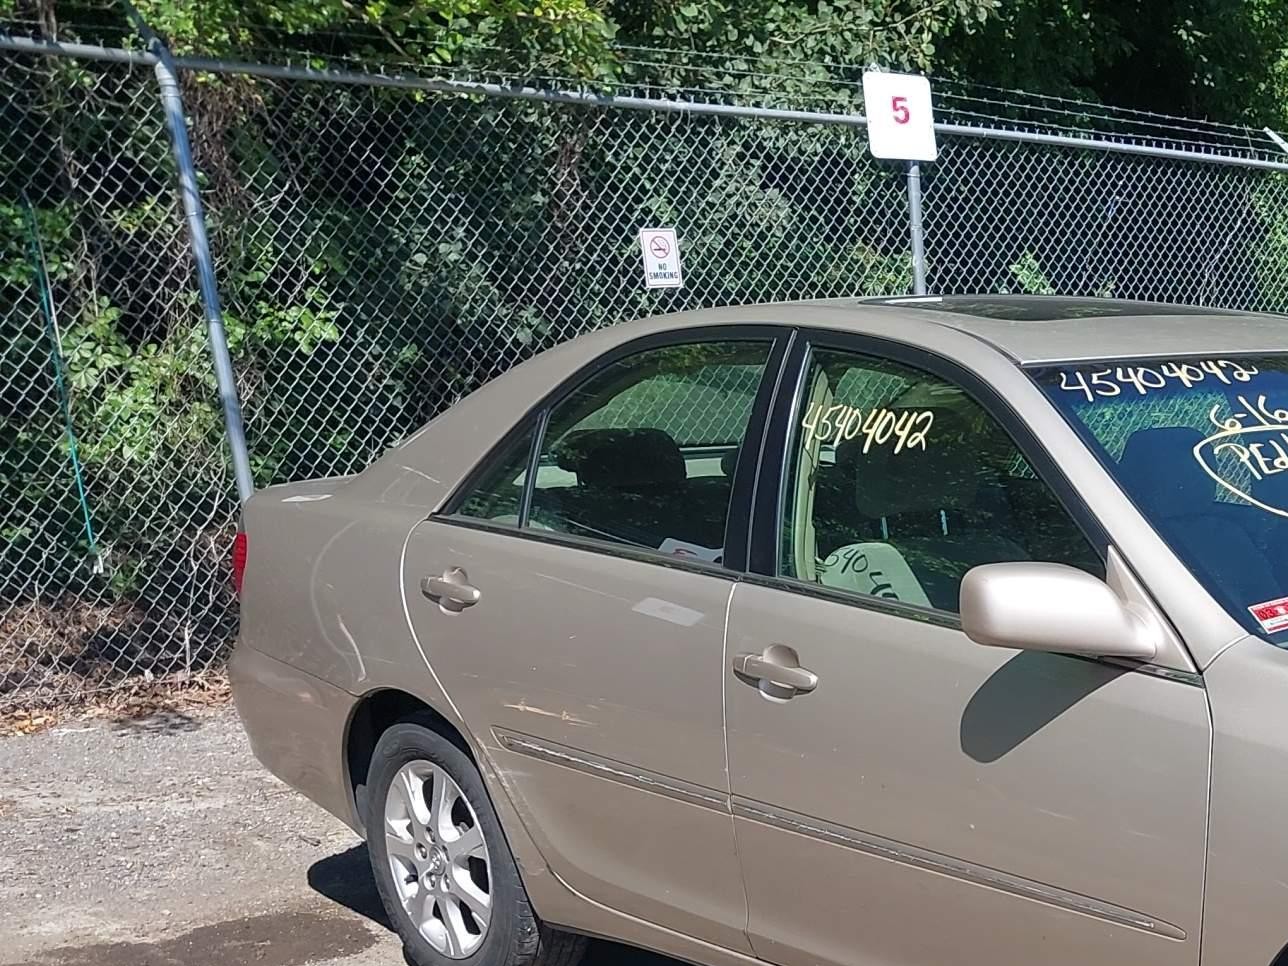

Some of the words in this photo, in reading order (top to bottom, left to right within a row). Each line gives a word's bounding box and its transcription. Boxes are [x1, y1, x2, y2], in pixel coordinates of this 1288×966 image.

[891, 95, 910, 125] 5
[648, 271, 679, 280] SMOKING
[657, 263, 668, 271] NO
[1059, 359, 1259, 403] 45404042
[801, 401, 934, 455] 45404042
